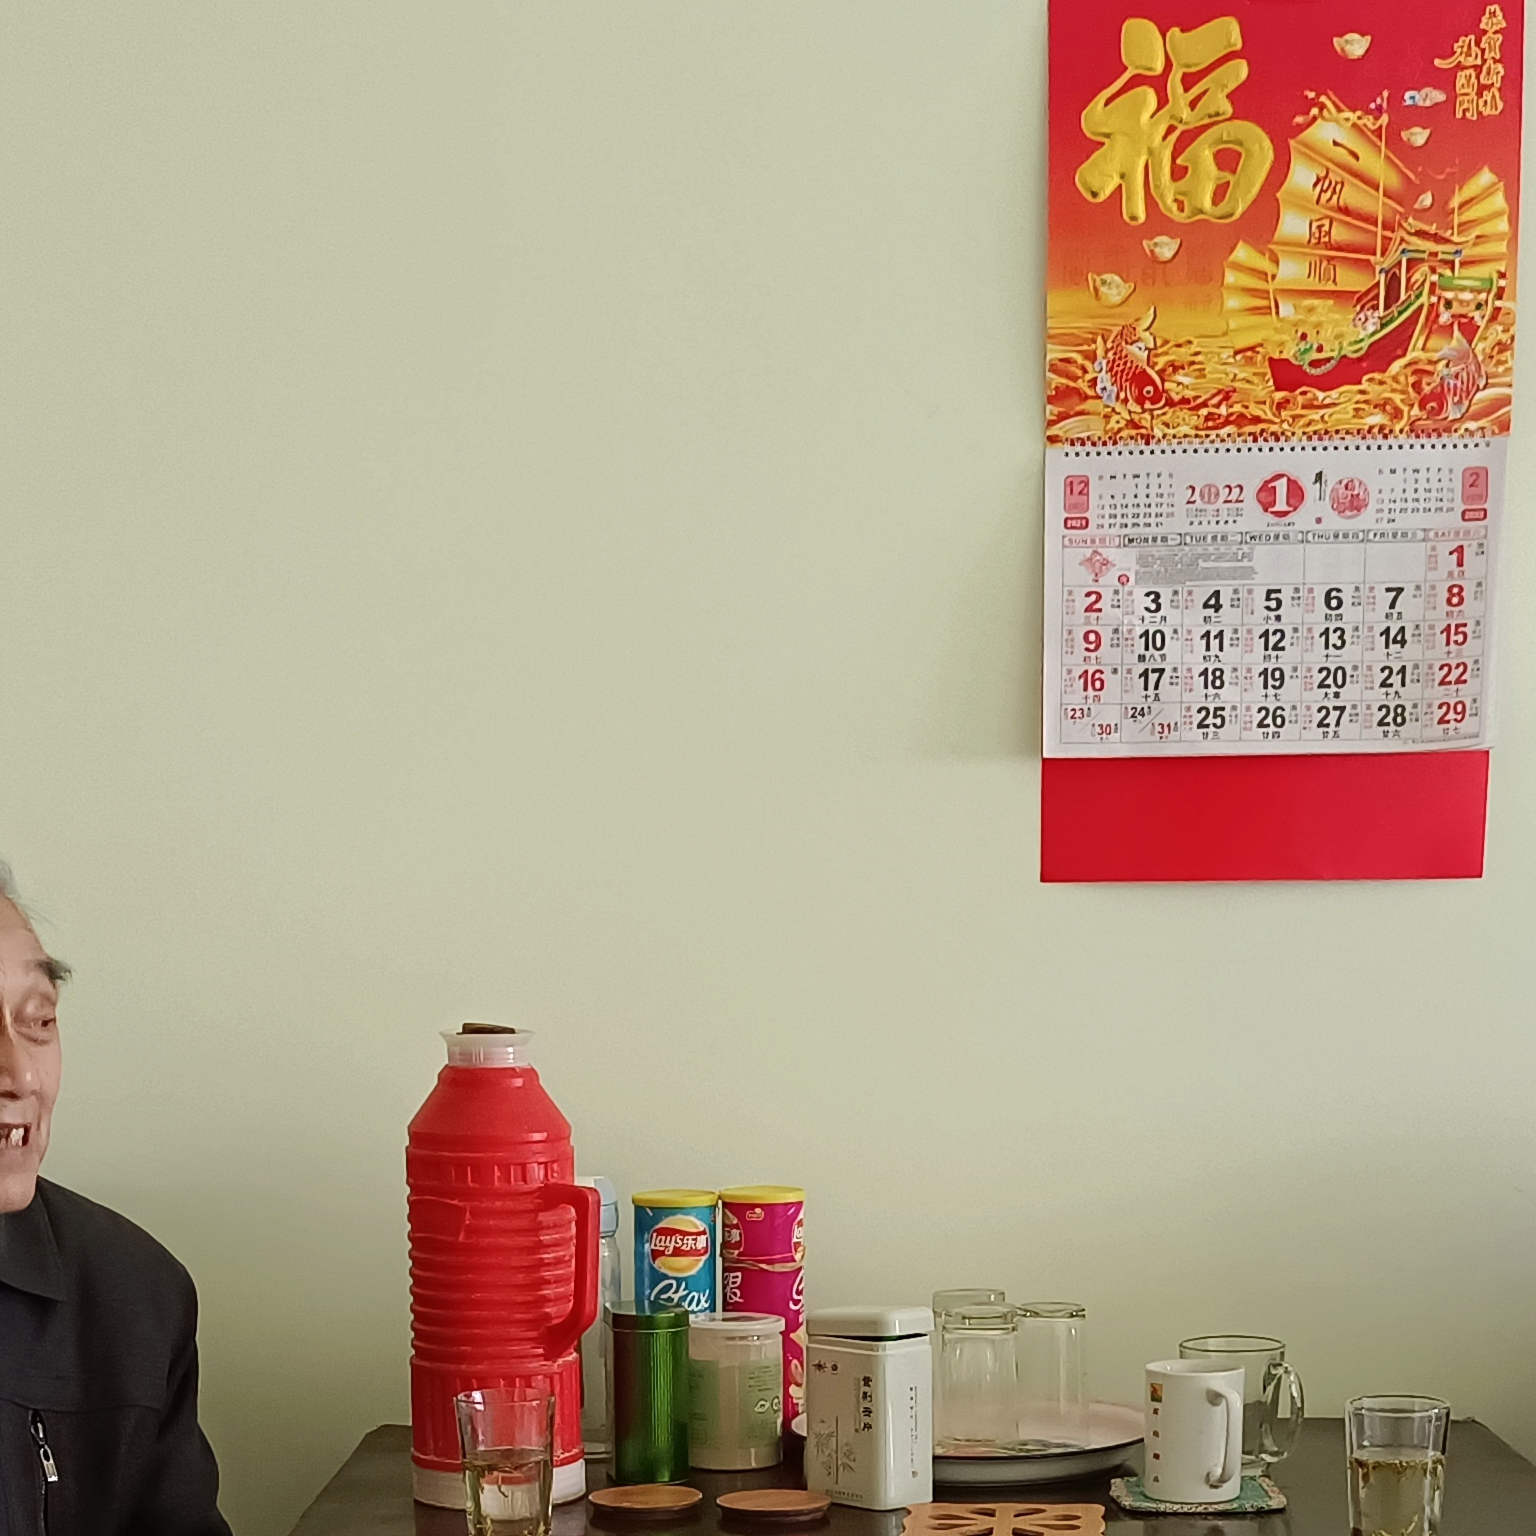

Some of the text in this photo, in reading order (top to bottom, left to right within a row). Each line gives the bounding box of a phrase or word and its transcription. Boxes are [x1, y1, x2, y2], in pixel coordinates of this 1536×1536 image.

[1075, 16, 1275, 224] 福
[1068, 480, 1088, 496] 12
[1267, 476, 1294, 512] 1
[1190, 534, 1208, 542] TUE
[1448, 544, 1464, 568] 1
[1084, 584, 1464, 613] 2 3 4 5 6 7 8
[1082, 622, 1468, 652] 9 10 11 12 13 14 15
[1078, 662, 1468, 692] 16 17 18 19 20 21 22
[1070, 707, 1146, 719] 23 24
[1196, 700, 1467, 729] 25 26 27 28 29
[1097, 723, 1171, 735] 30 31
[651, 1232, 683, 1255] Lay's
[650, 1278, 711, 1312] Stax
